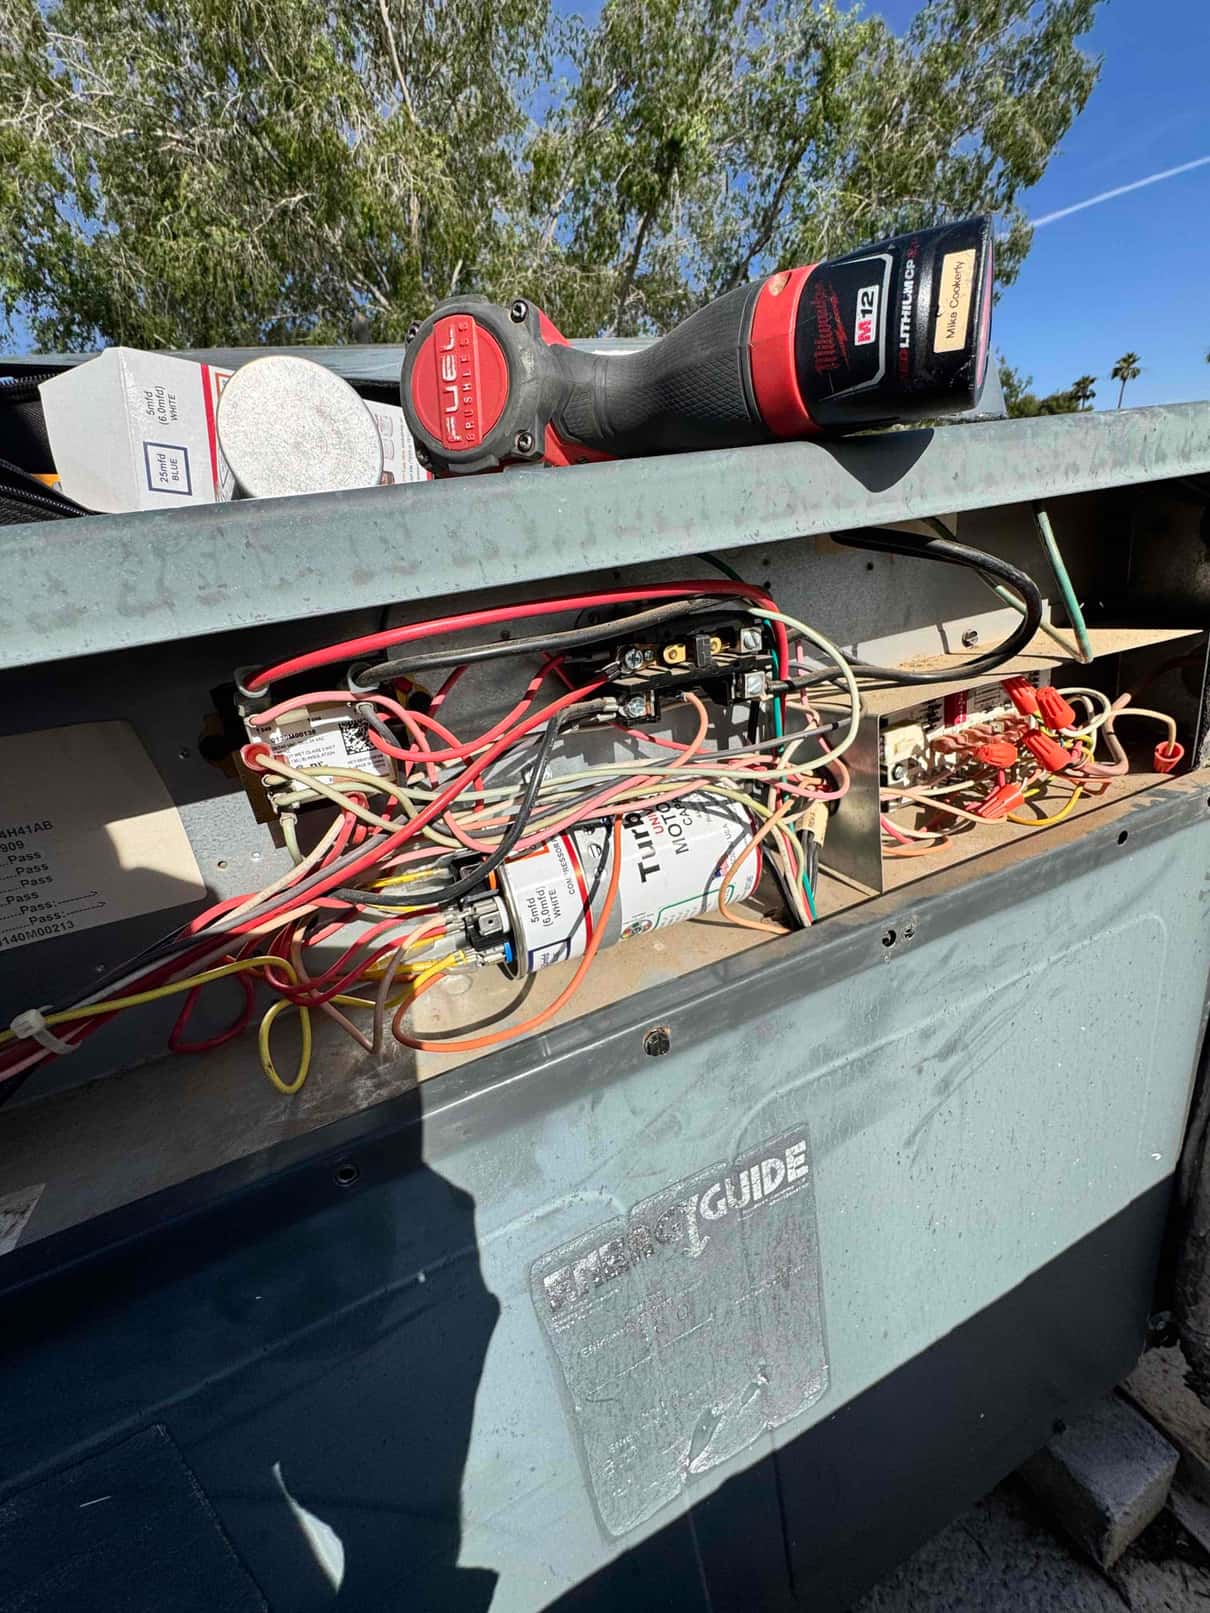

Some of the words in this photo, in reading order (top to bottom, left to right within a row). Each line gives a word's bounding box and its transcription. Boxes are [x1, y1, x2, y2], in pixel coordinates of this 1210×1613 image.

[857, 289, 875, 343] M12
[945, 310, 958, 338] Mike
[441, 326, 461, 442] FUEL
[458, 321, 475, 441] BRUSHLESS
[144, 390, 155, 415] 5mfd
[155, 385, 168, 425] (6.0mfd)
[168, 393, 178, 421] WHITE
[157, 453, 168, 483] 25mfd
[170, 457, 179, 481] BLUE
[656, 801, 689, 855] MOTO
[7, 851, 41, 864] Pass
[623, 811, 661, 883] Turb
[16, 863, 49, 875] Pass
[20, 875, 53, 887] Pass
[5, 892, 39, 904] Pass
[527, 898, 540, 924] 5mfd
[549, 887, 561, 919] WHITE
[0, 920, 74, 947] 140M00213
[699, 1139, 809, 1221] GUIDE
